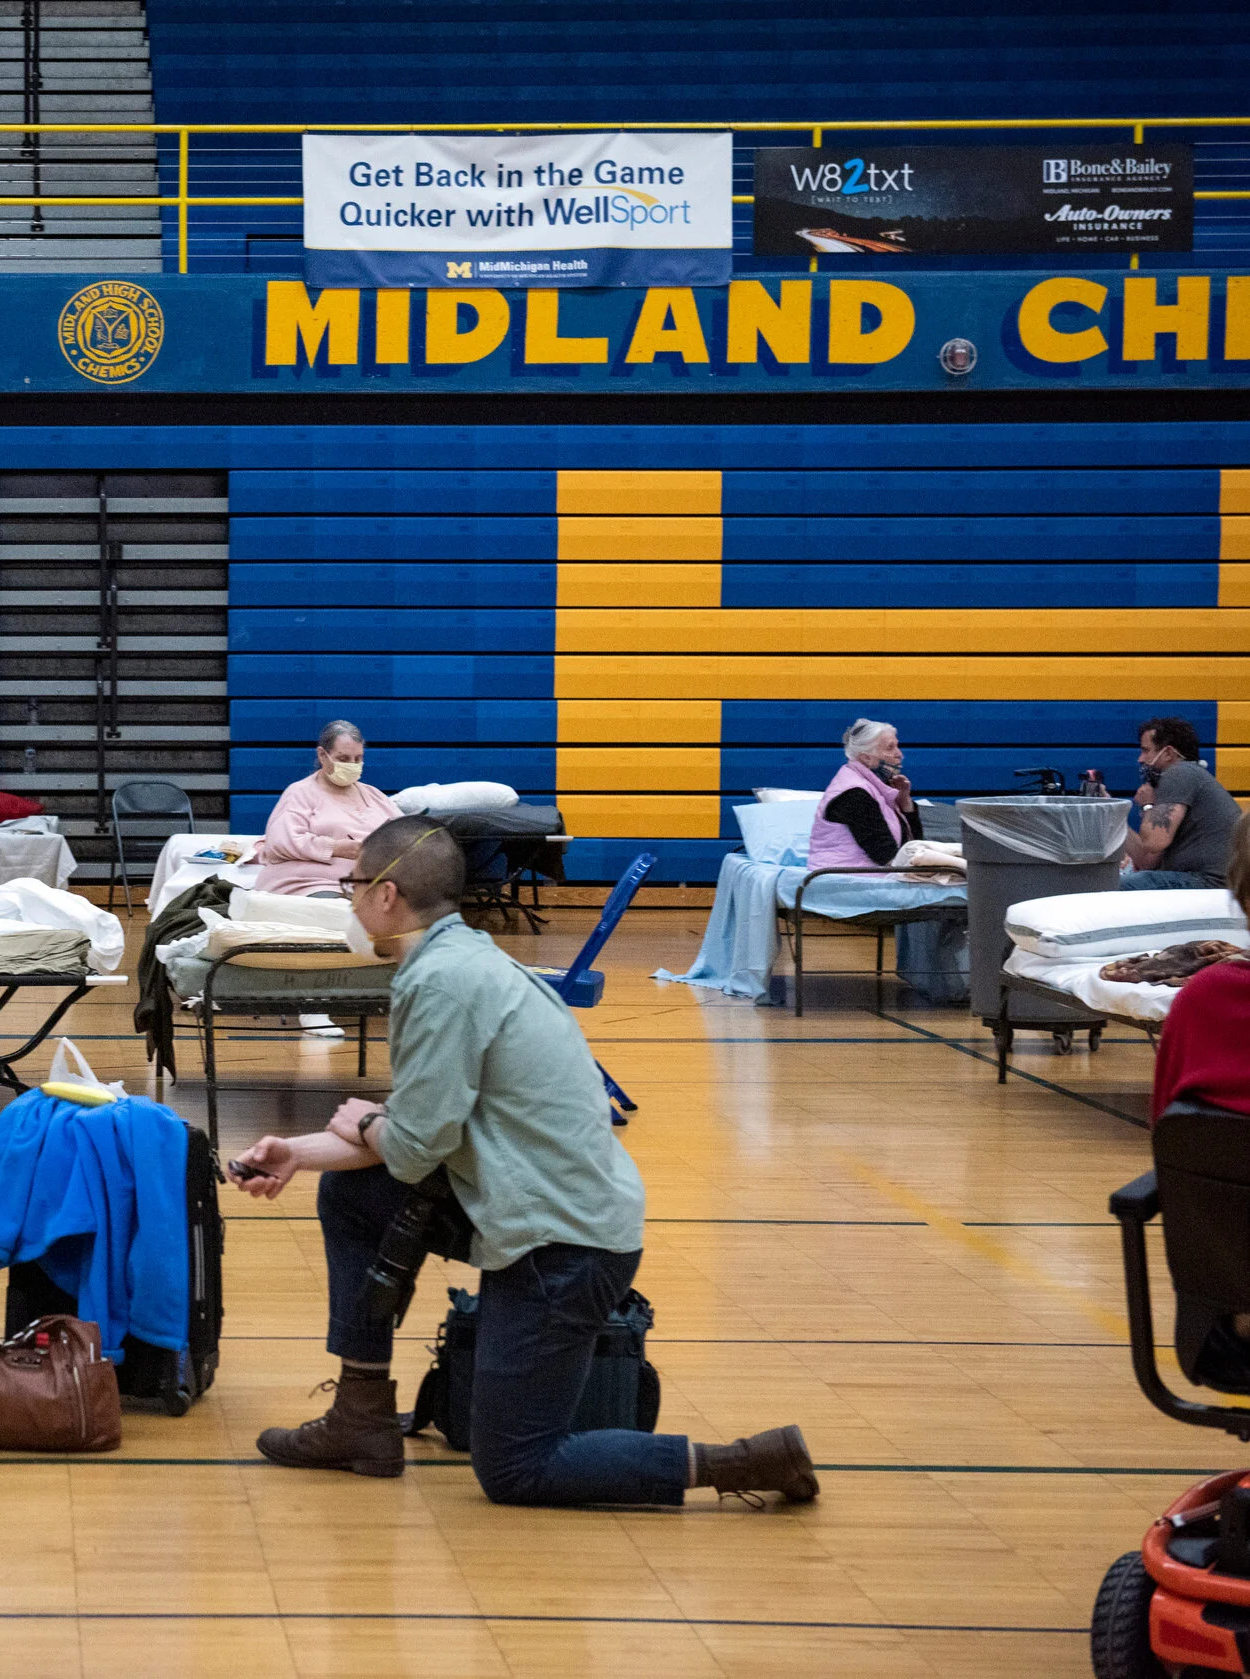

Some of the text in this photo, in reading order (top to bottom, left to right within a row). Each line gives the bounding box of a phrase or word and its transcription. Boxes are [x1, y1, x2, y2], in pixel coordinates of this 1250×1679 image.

[349, 159, 685, 188] Get Back in the Game
[790, 158, 914, 195] W82txt
[1070, 158, 1172, 179] Bone&Bailey
[340, 195, 692, 231] Quicker with WellSport
[1044, 203, 1173, 221] Auto-Owners
[1073, 221, 1144, 231] INSURANCE
[478, 259, 588, 273] MidMichigan Health
[62, 284, 161, 354] MIDLAND HIGH SCHOOL
[265, 280, 915, 368] MIDLAND
[77, 357, 141, 378] CHEMICS
